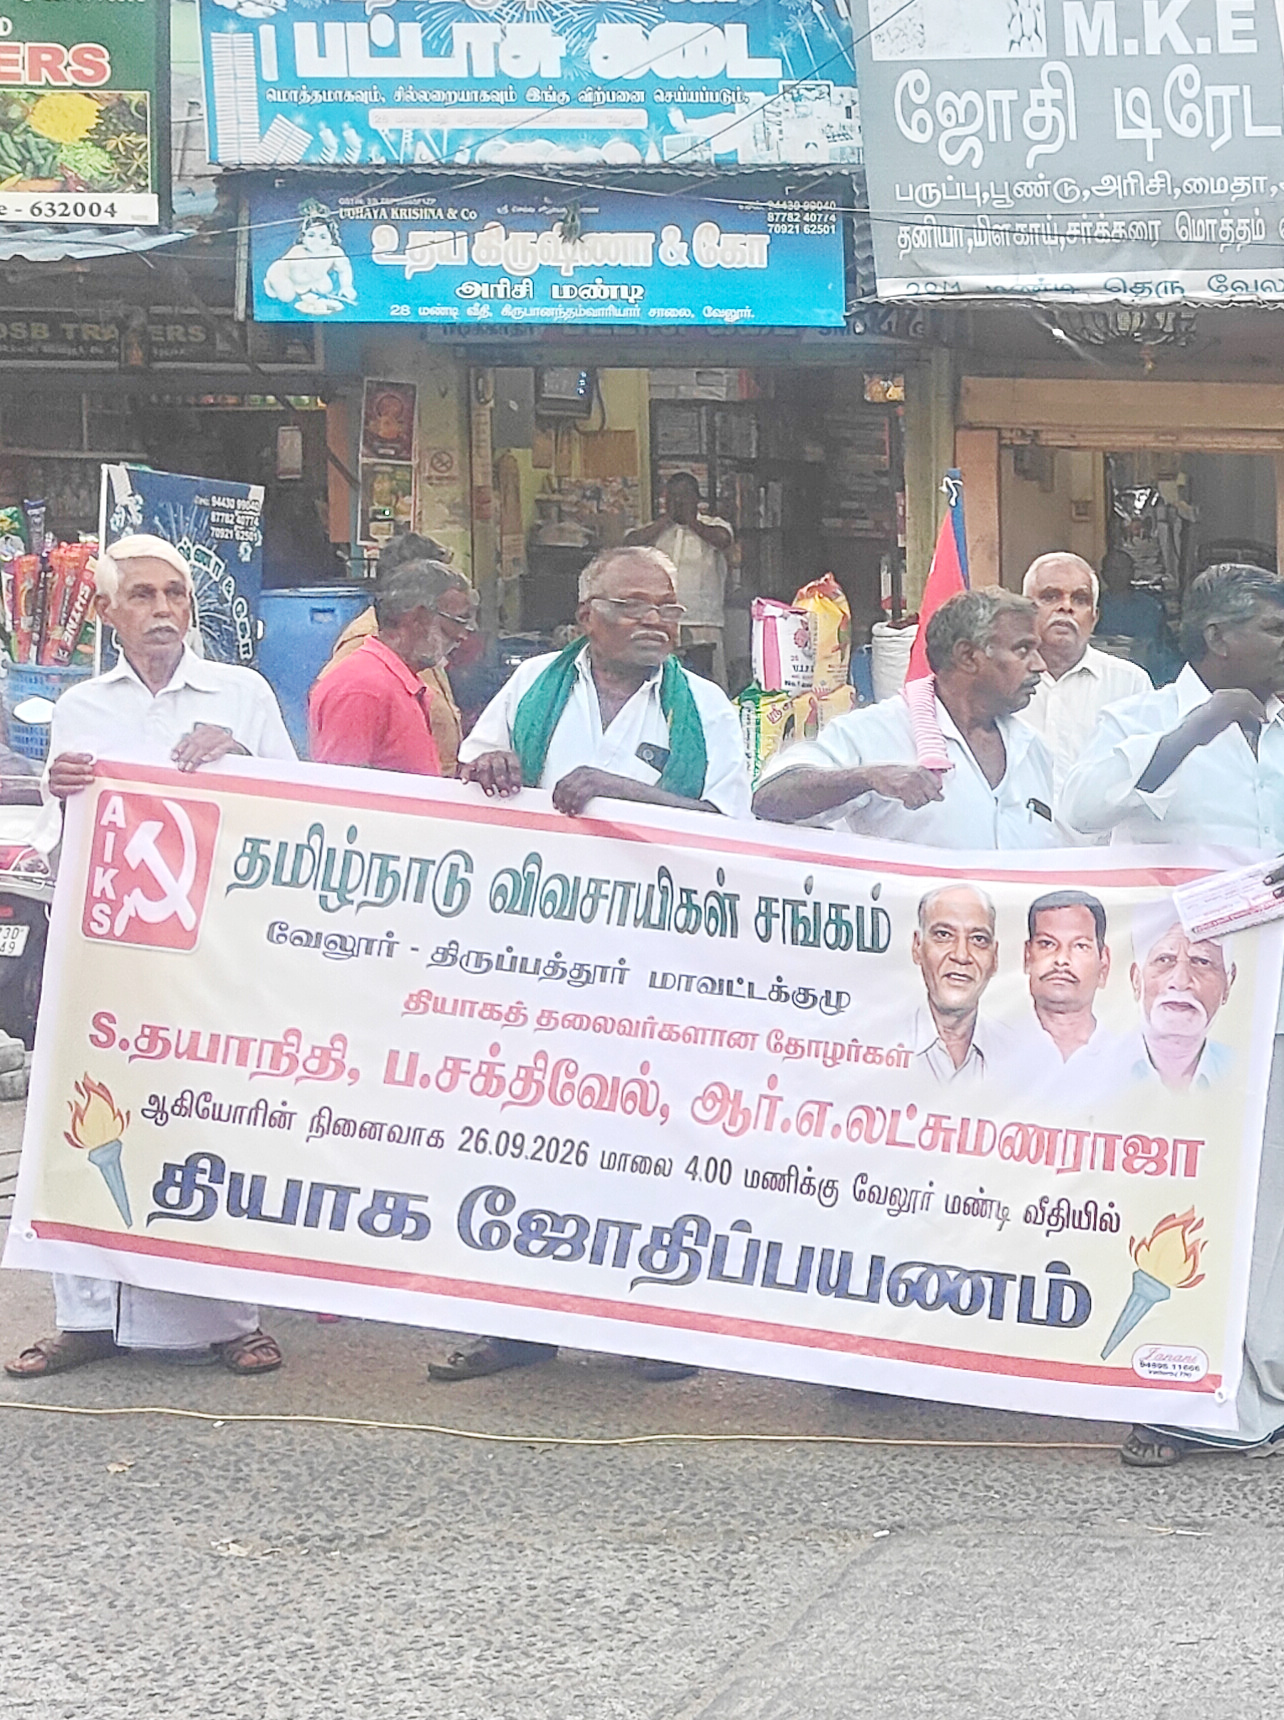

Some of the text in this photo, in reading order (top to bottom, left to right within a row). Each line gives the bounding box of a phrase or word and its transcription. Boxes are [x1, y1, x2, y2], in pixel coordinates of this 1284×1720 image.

[293, 13, 783, 80] பட்டாசு கடை
[1063, 0, 1259, 57] M.K.E
[266, 85, 387, 105] மொத்தமாகவும்,
[525, 85, 571, 105] இங்கு
[577, 85, 646, 108] விற்பனை
[894, 61, 1078, 169] ஜோதி
[29, 201, 118, 218] 632004
[390, 207, 445, 221] KRISHNA
[446, 207, 458, 220] &
[459, 208, 478, 221] Co
[767, 212, 801, 223] 87782
[767, 223, 836, 235] 70921 62501
[1174, 207, 1266, 253] மொத்தம்
[371, 223, 469, 280] உதய
[658, 224, 691, 267] &
[692, 221, 771, 269] கோ
[389, 304, 411, 317] 28
[417, 302, 460, 320] மண்டி
[455, 276, 645, 304] அரிசி மண்டி
[60, 322, 207, 343] TRAERS
[88, 795, 127, 937] AIKS
[225, 821, 893, 955] தமிழ்நாடு விவசாயிகள் சங்கம்
[265, 919, 852, 1017] வேலூர் திருப்பத்தூர் மாவட்டக்குழு
[402, 989, 915, 1069] தியாகத் தலைவர்களான தோழர்கள்
[88, 1011, 1206, 1179] S.தயாநிதி, ப.சக்திவேல், ஆர்.எ.லட்சுமணராஜா
[140, 1089, 1123, 1239] ஆகியோரின் நினைவாக 26.09.2026 மாலை 4.00 மணிக்கு வேலூர் மண்டி வீதியில்
[146, 1150, 1094, 1331] தியாக ஜோதிப்பயணம்
